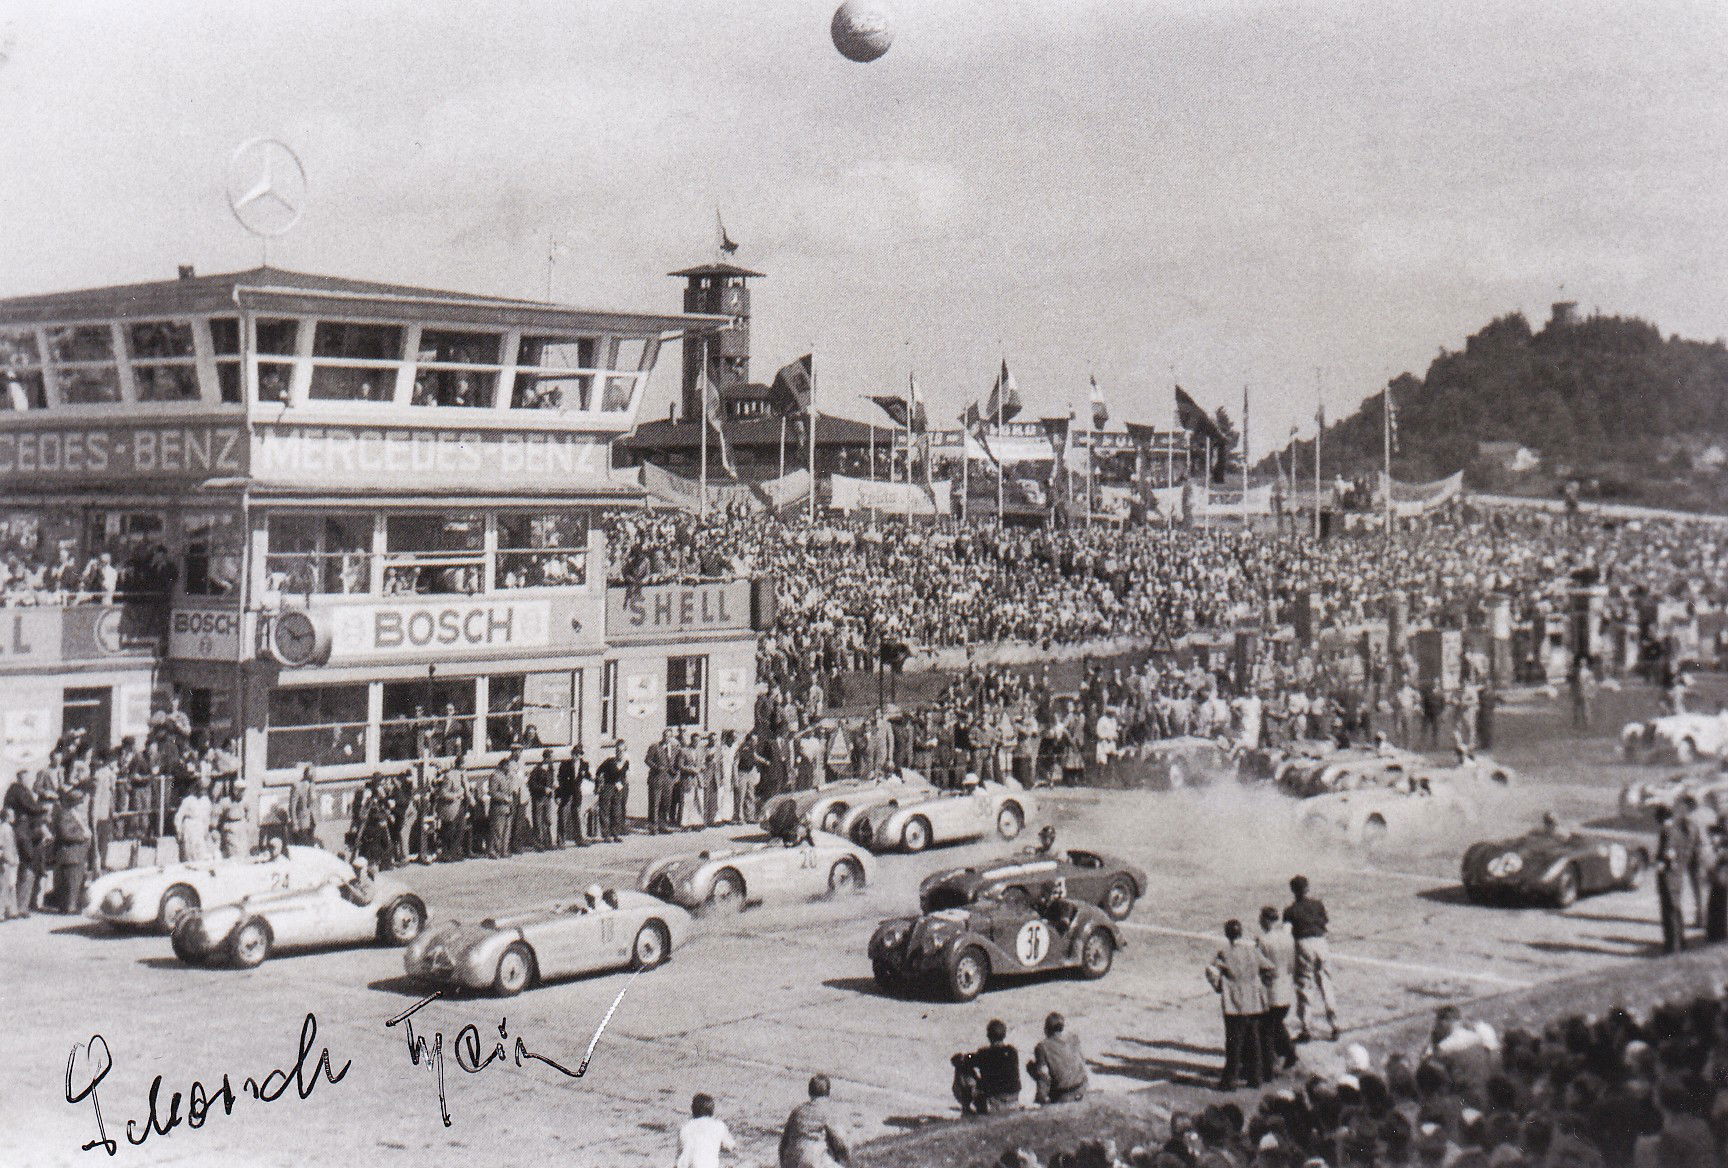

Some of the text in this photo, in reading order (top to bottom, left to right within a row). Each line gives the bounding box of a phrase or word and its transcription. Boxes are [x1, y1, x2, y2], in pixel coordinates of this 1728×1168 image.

[175, 612, 240, 635] BOSCH
[630, 589, 731, 626] SHELL
[374, 607, 513, 648] BOSCH
